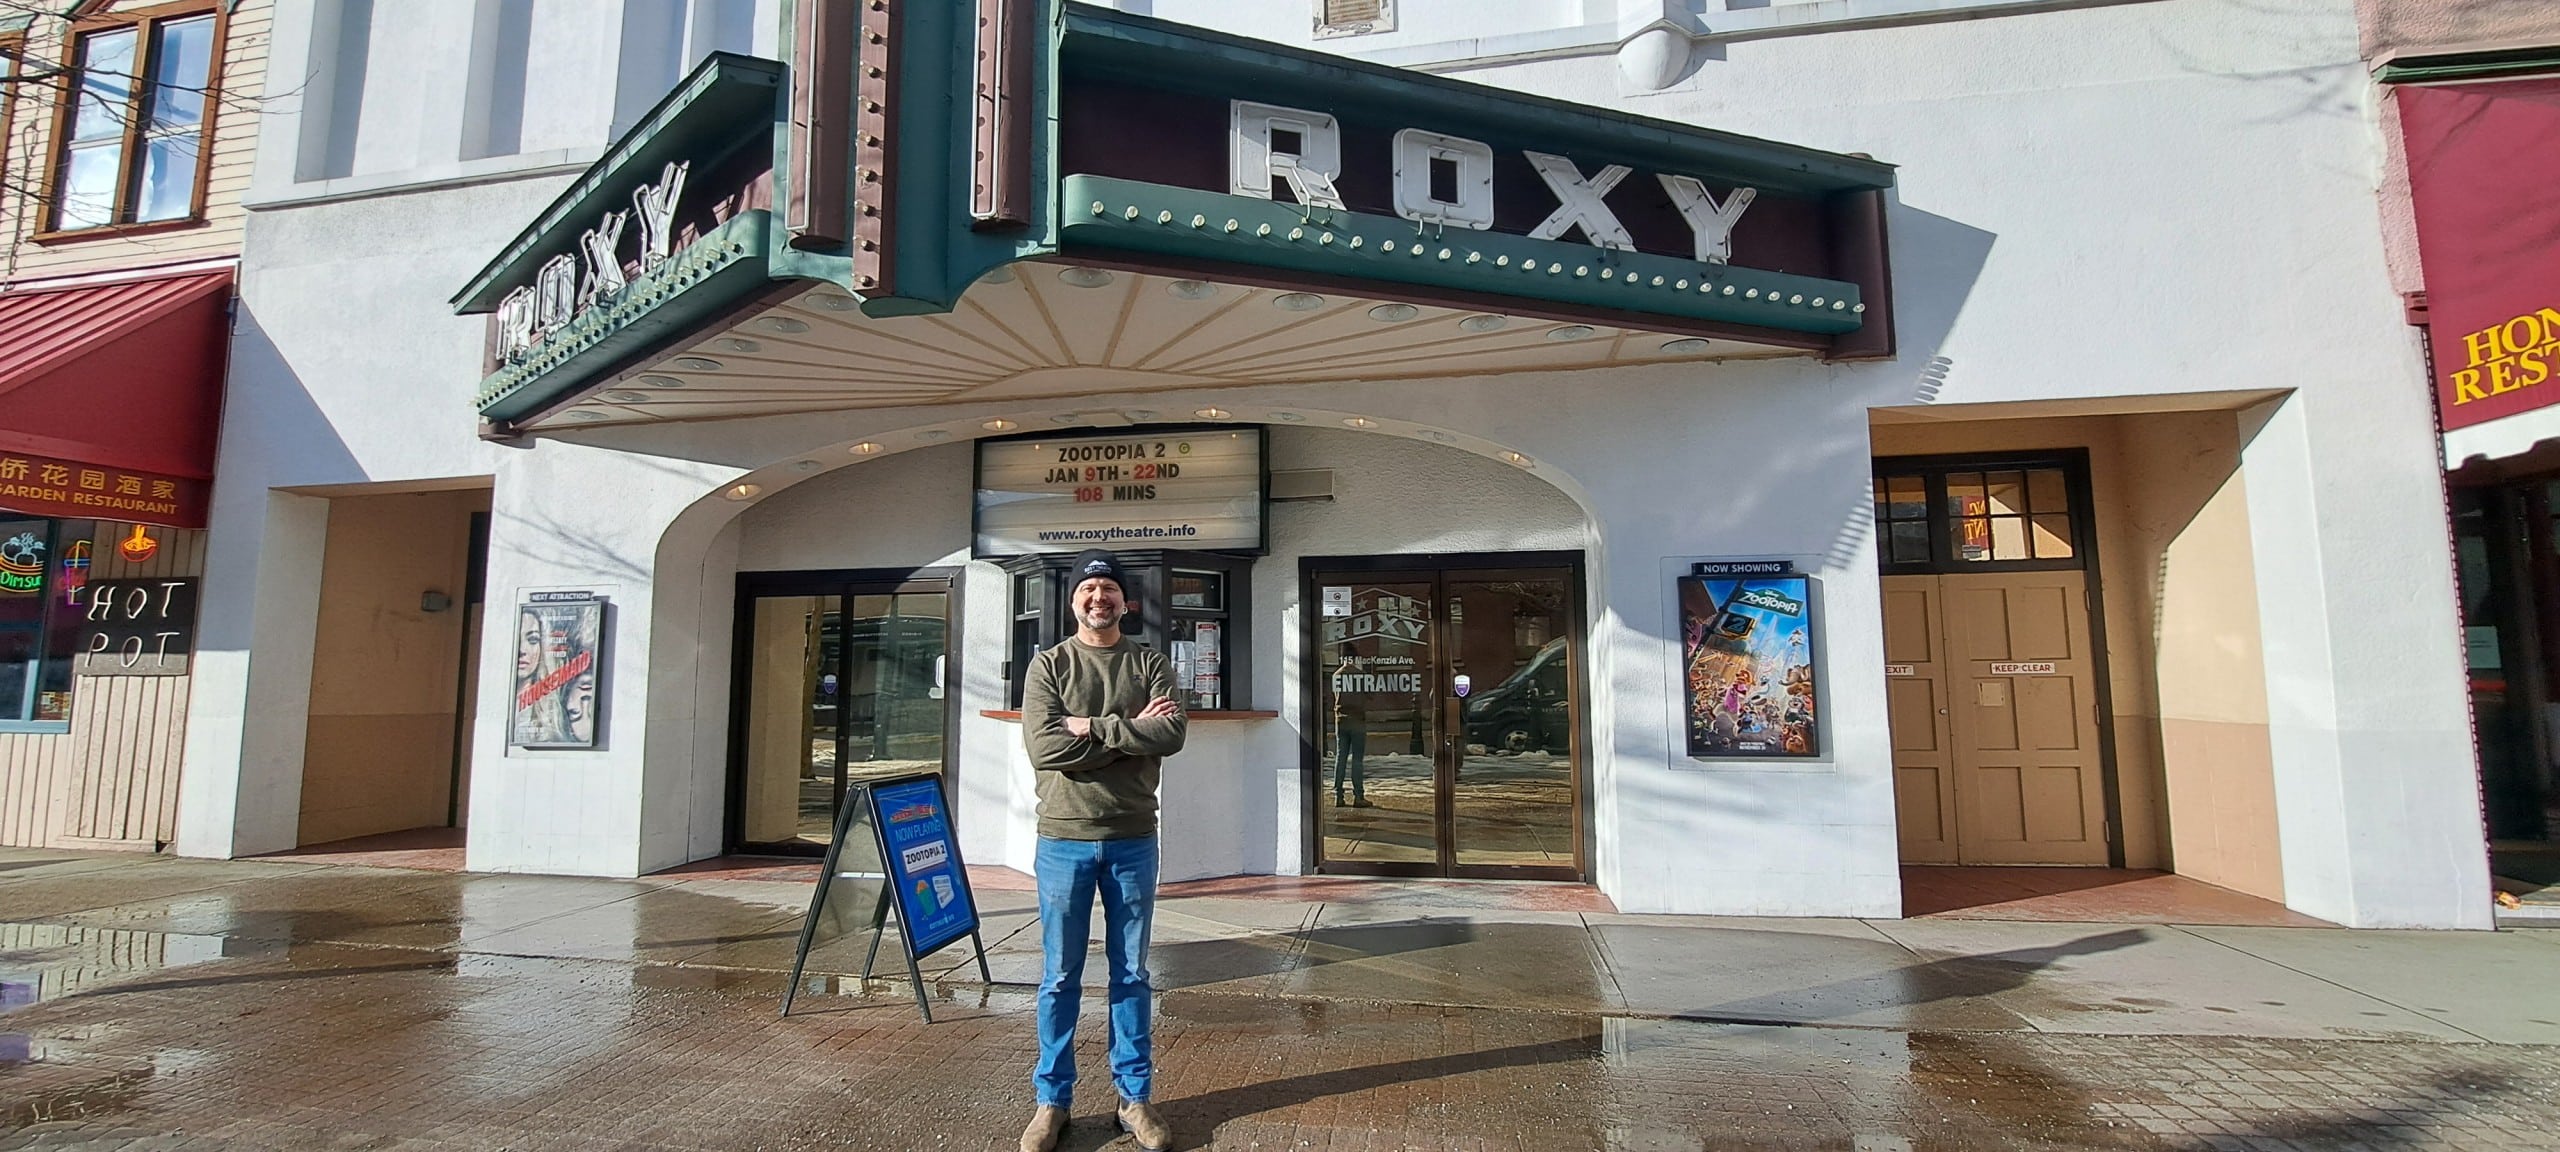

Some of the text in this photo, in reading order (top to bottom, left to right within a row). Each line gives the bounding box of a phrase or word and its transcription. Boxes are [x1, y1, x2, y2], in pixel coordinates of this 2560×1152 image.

[1230, 98, 1757, 264] ROXY
[496, 160, 690, 364] ROXY
[1059, 444, 1146, 462] ZOOTOPIA
[1155, 443, 1166, 459] 2
[1045, 467, 1079, 483] JAN
[0, 483, 178, 514] ARDEN RESTAURANT
[1073, 485, 1156, 503] 108 MINS
[1039, 524, 1196, 542] www.roxytheatre.info
[1704, 563, 1782, 573] NOW SHOWING
[87, 582, 185, 621] HOT
[1327, 614, 1424, 641] ROXY
[1728, 617, 1745, 632] 2
[84, 631, 180, 669] POT
[1339, 656, 1416, 665] 115 MacKenzie Ave.
[1886, 666, 1908, 674] EXIT
[1995, 664, 2051, 672] KEEP CLEAR
[518, 651, 591, 712] HOUSEMAID
[1332, 674, 1421, 692] ENTRANCE
[895, 820, 942, 842] NOW PLAYING
[905, 845, 946, 864] ZOOTOPIA 2
